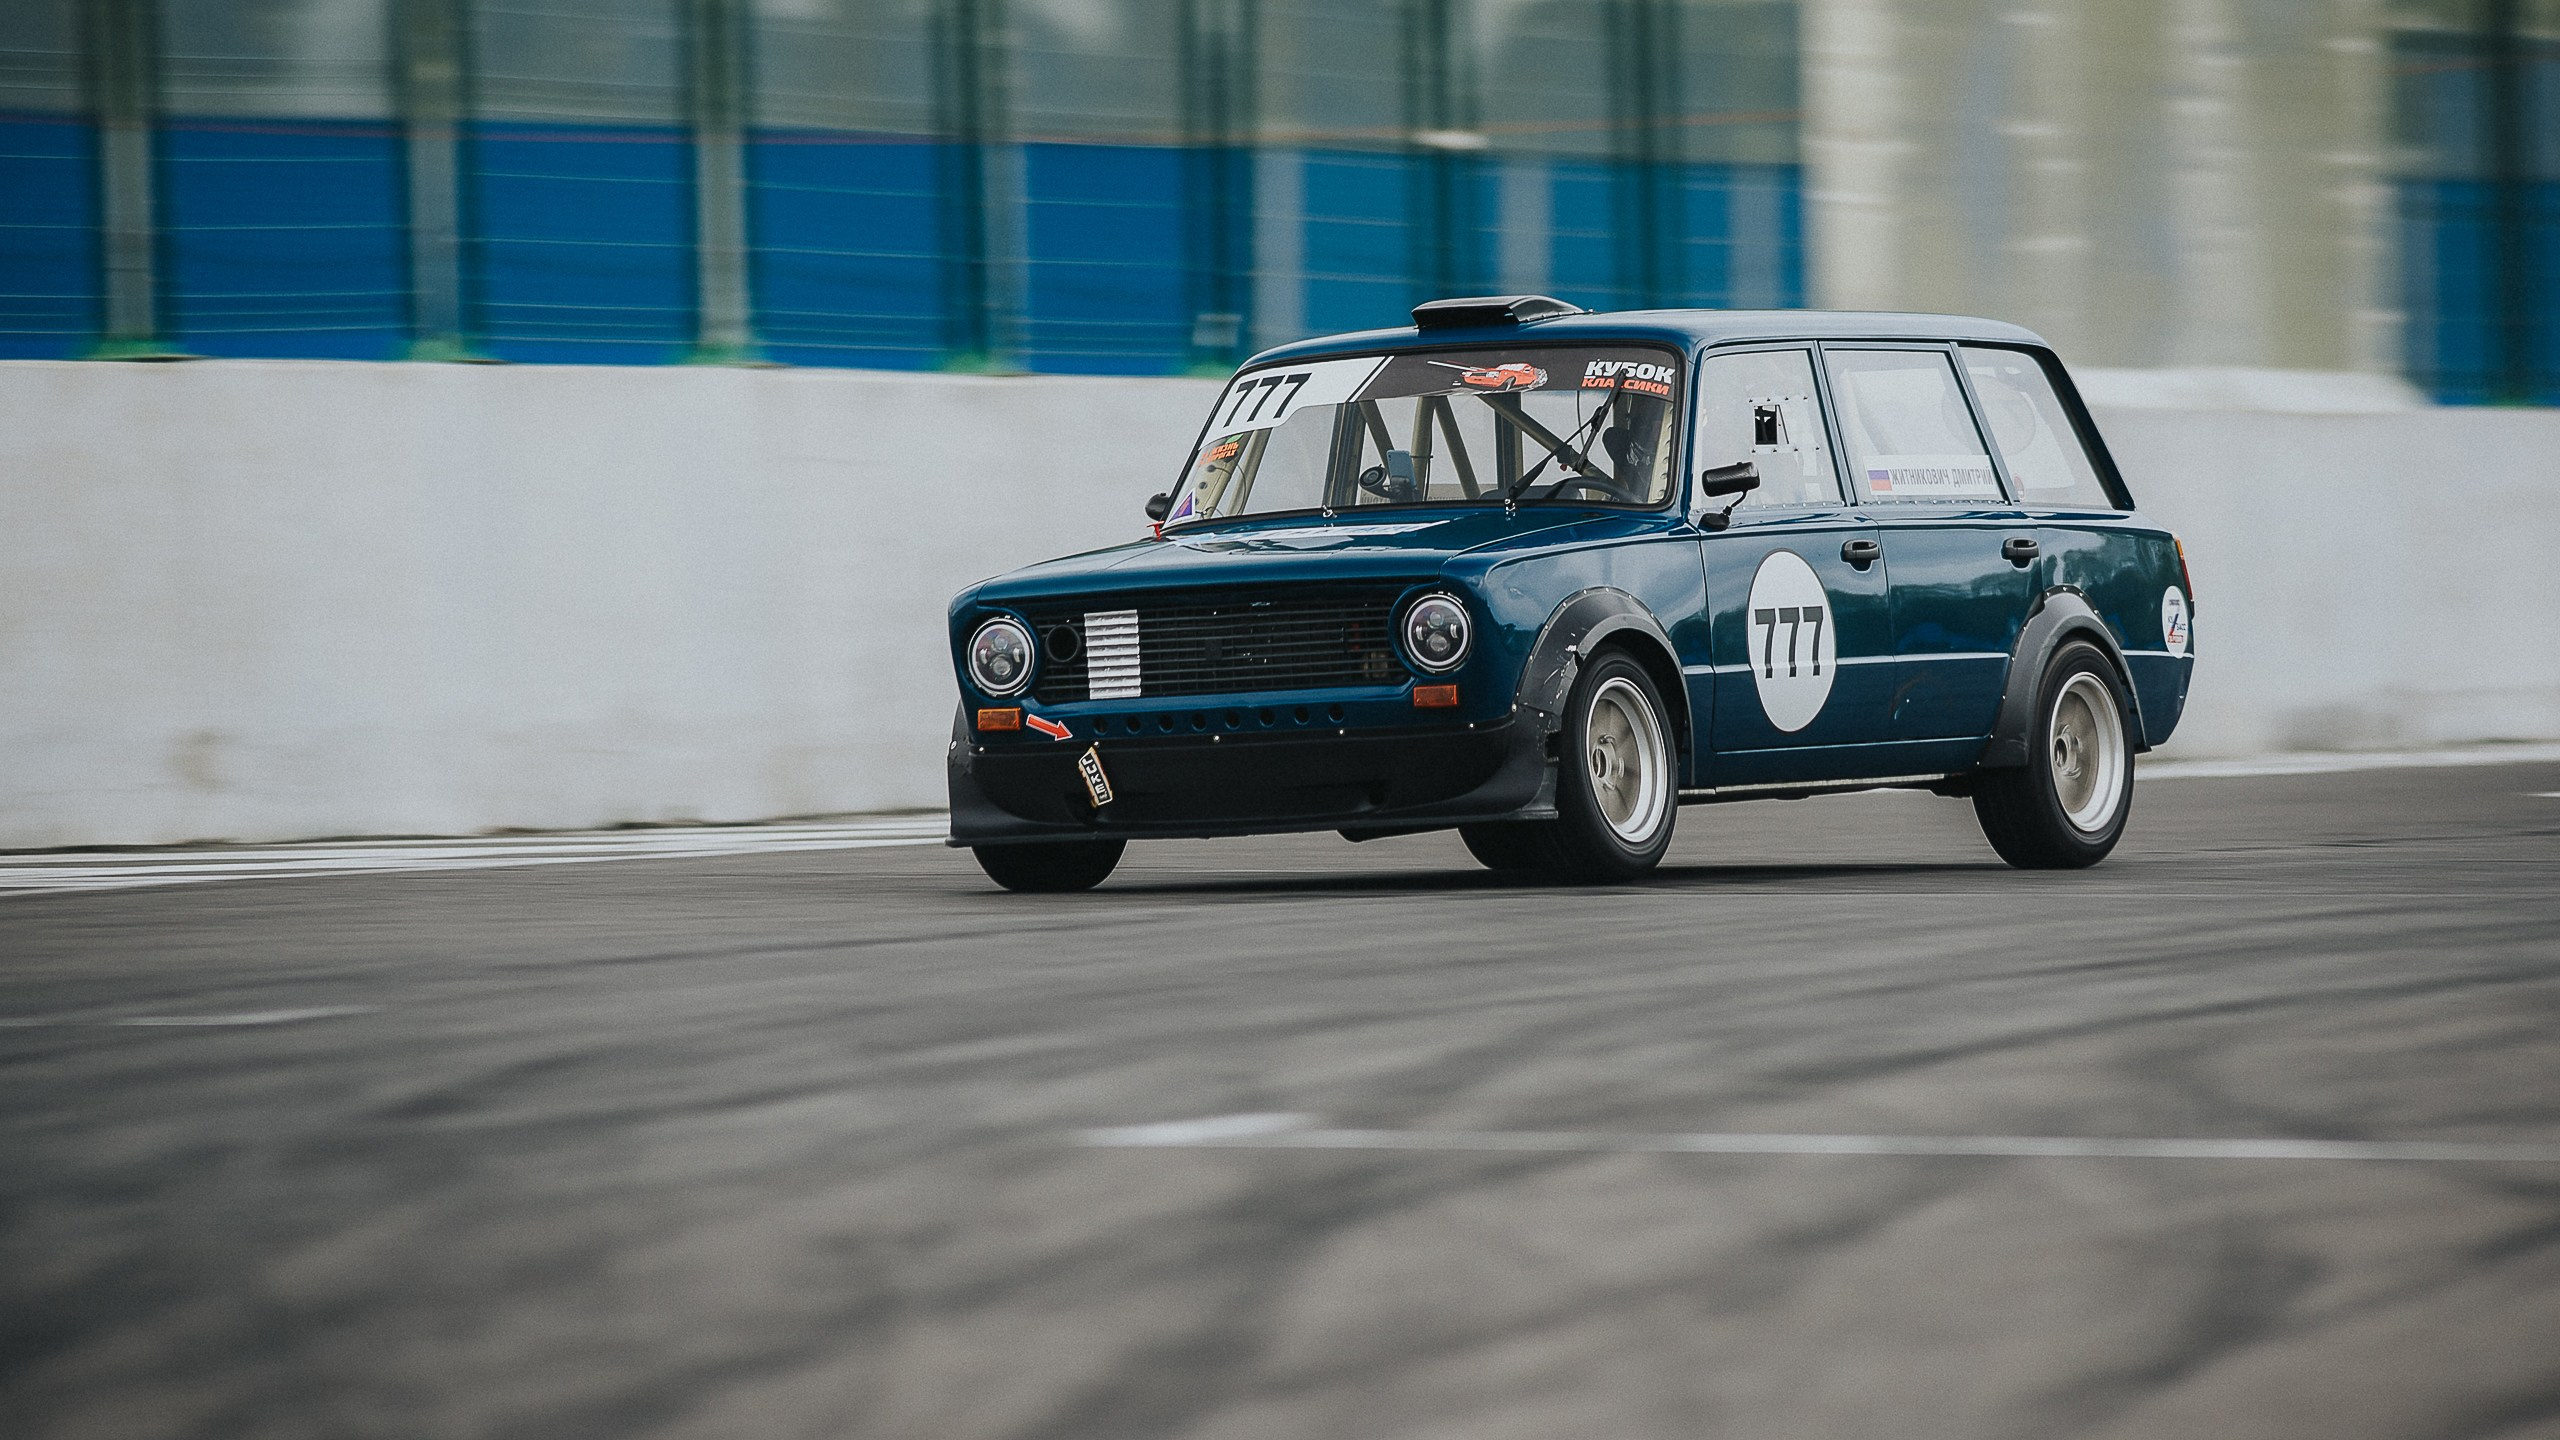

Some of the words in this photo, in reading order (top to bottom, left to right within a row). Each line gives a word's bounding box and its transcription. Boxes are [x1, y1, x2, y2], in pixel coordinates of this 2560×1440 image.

[1584, 360, 1675, 384] КУБОК
[1581, 377, 1669, 395] КЛАСИКИ
[1223, 373, 1312, 428] 777
[1889, 468, 1950, 485] ЖИТНИКОВИЧ
[1951, 466, 1993, 488] ДМИТРИЙ
[1754, 606, 1823, 679] 777
